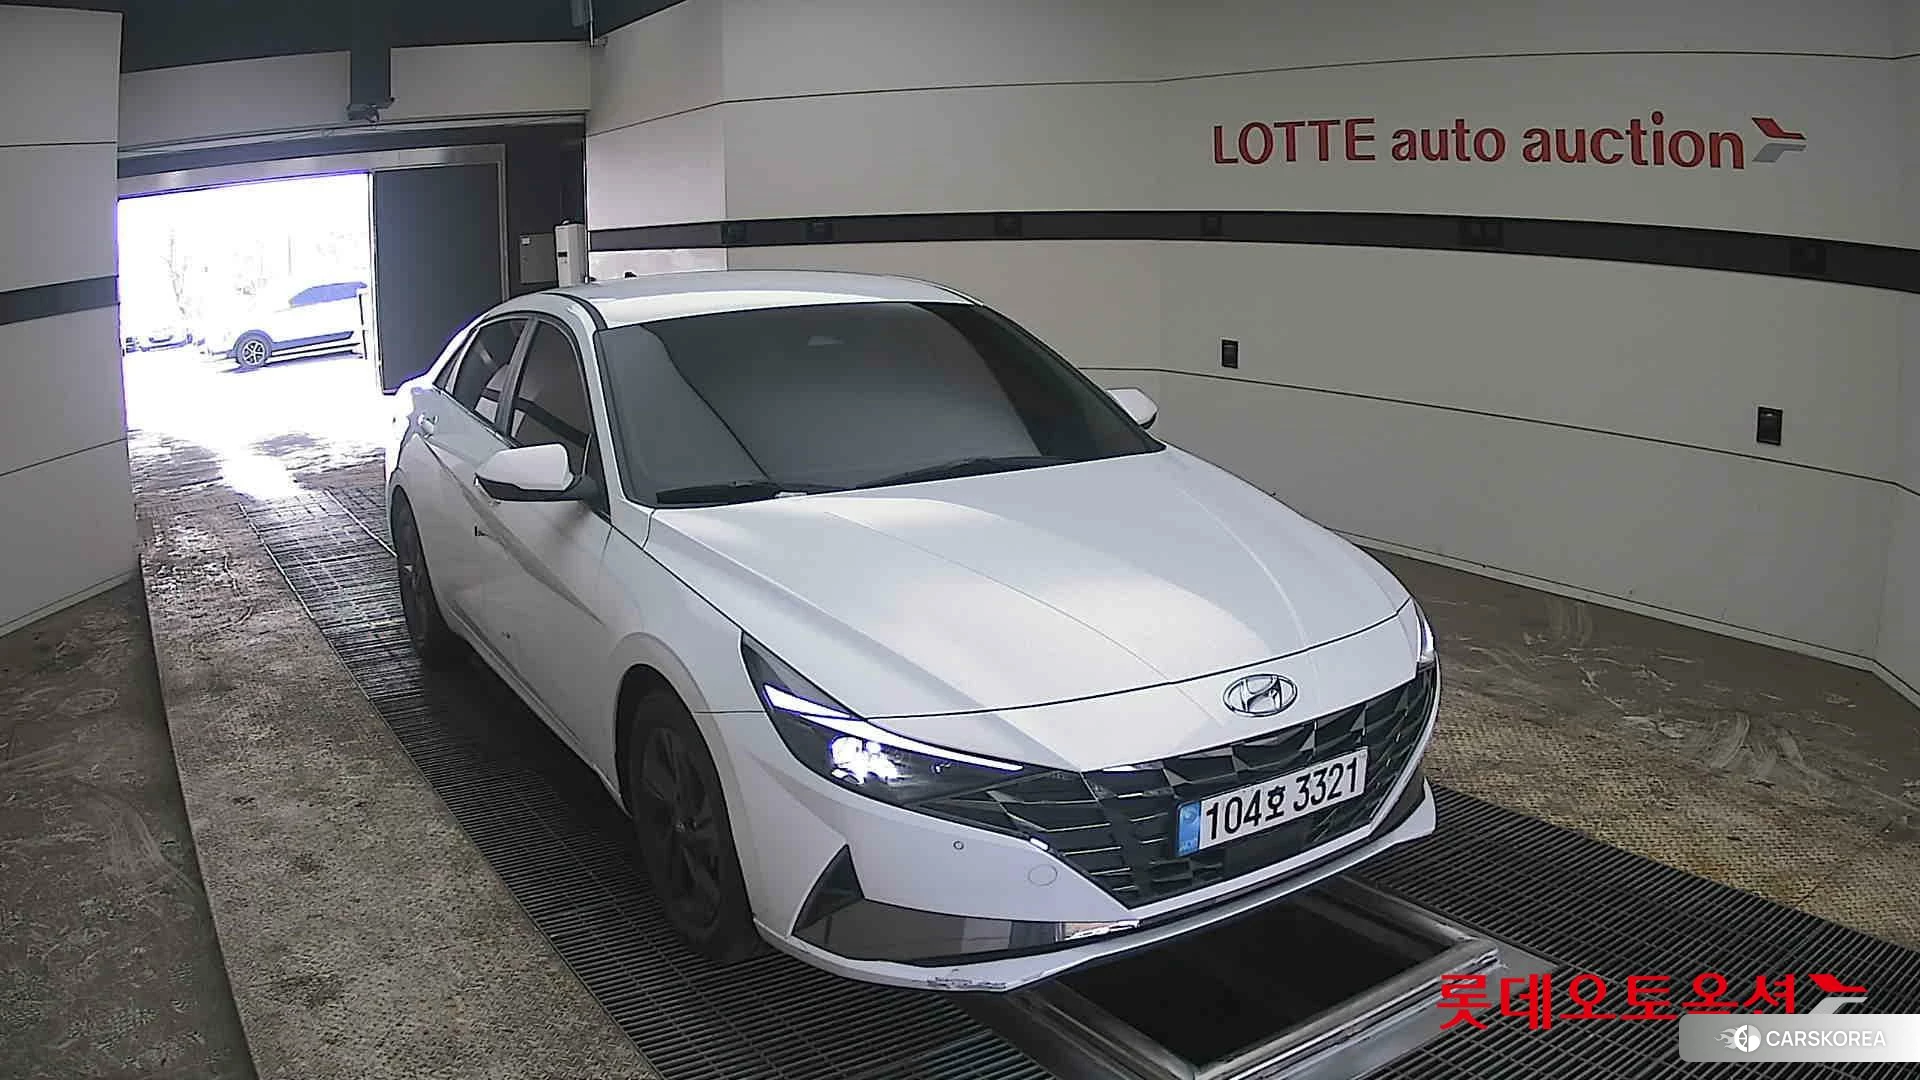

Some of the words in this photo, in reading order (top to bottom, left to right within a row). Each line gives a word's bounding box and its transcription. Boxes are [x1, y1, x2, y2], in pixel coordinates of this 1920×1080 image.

[1213, 117, 1376, 165] LOTTE
[1391, 118, 1506, 163] auto
[1522, 111, 1745, 170] auction
[1205, 784, 1287, 841] 104호
[1293, 757, 1358, 812] 3321
